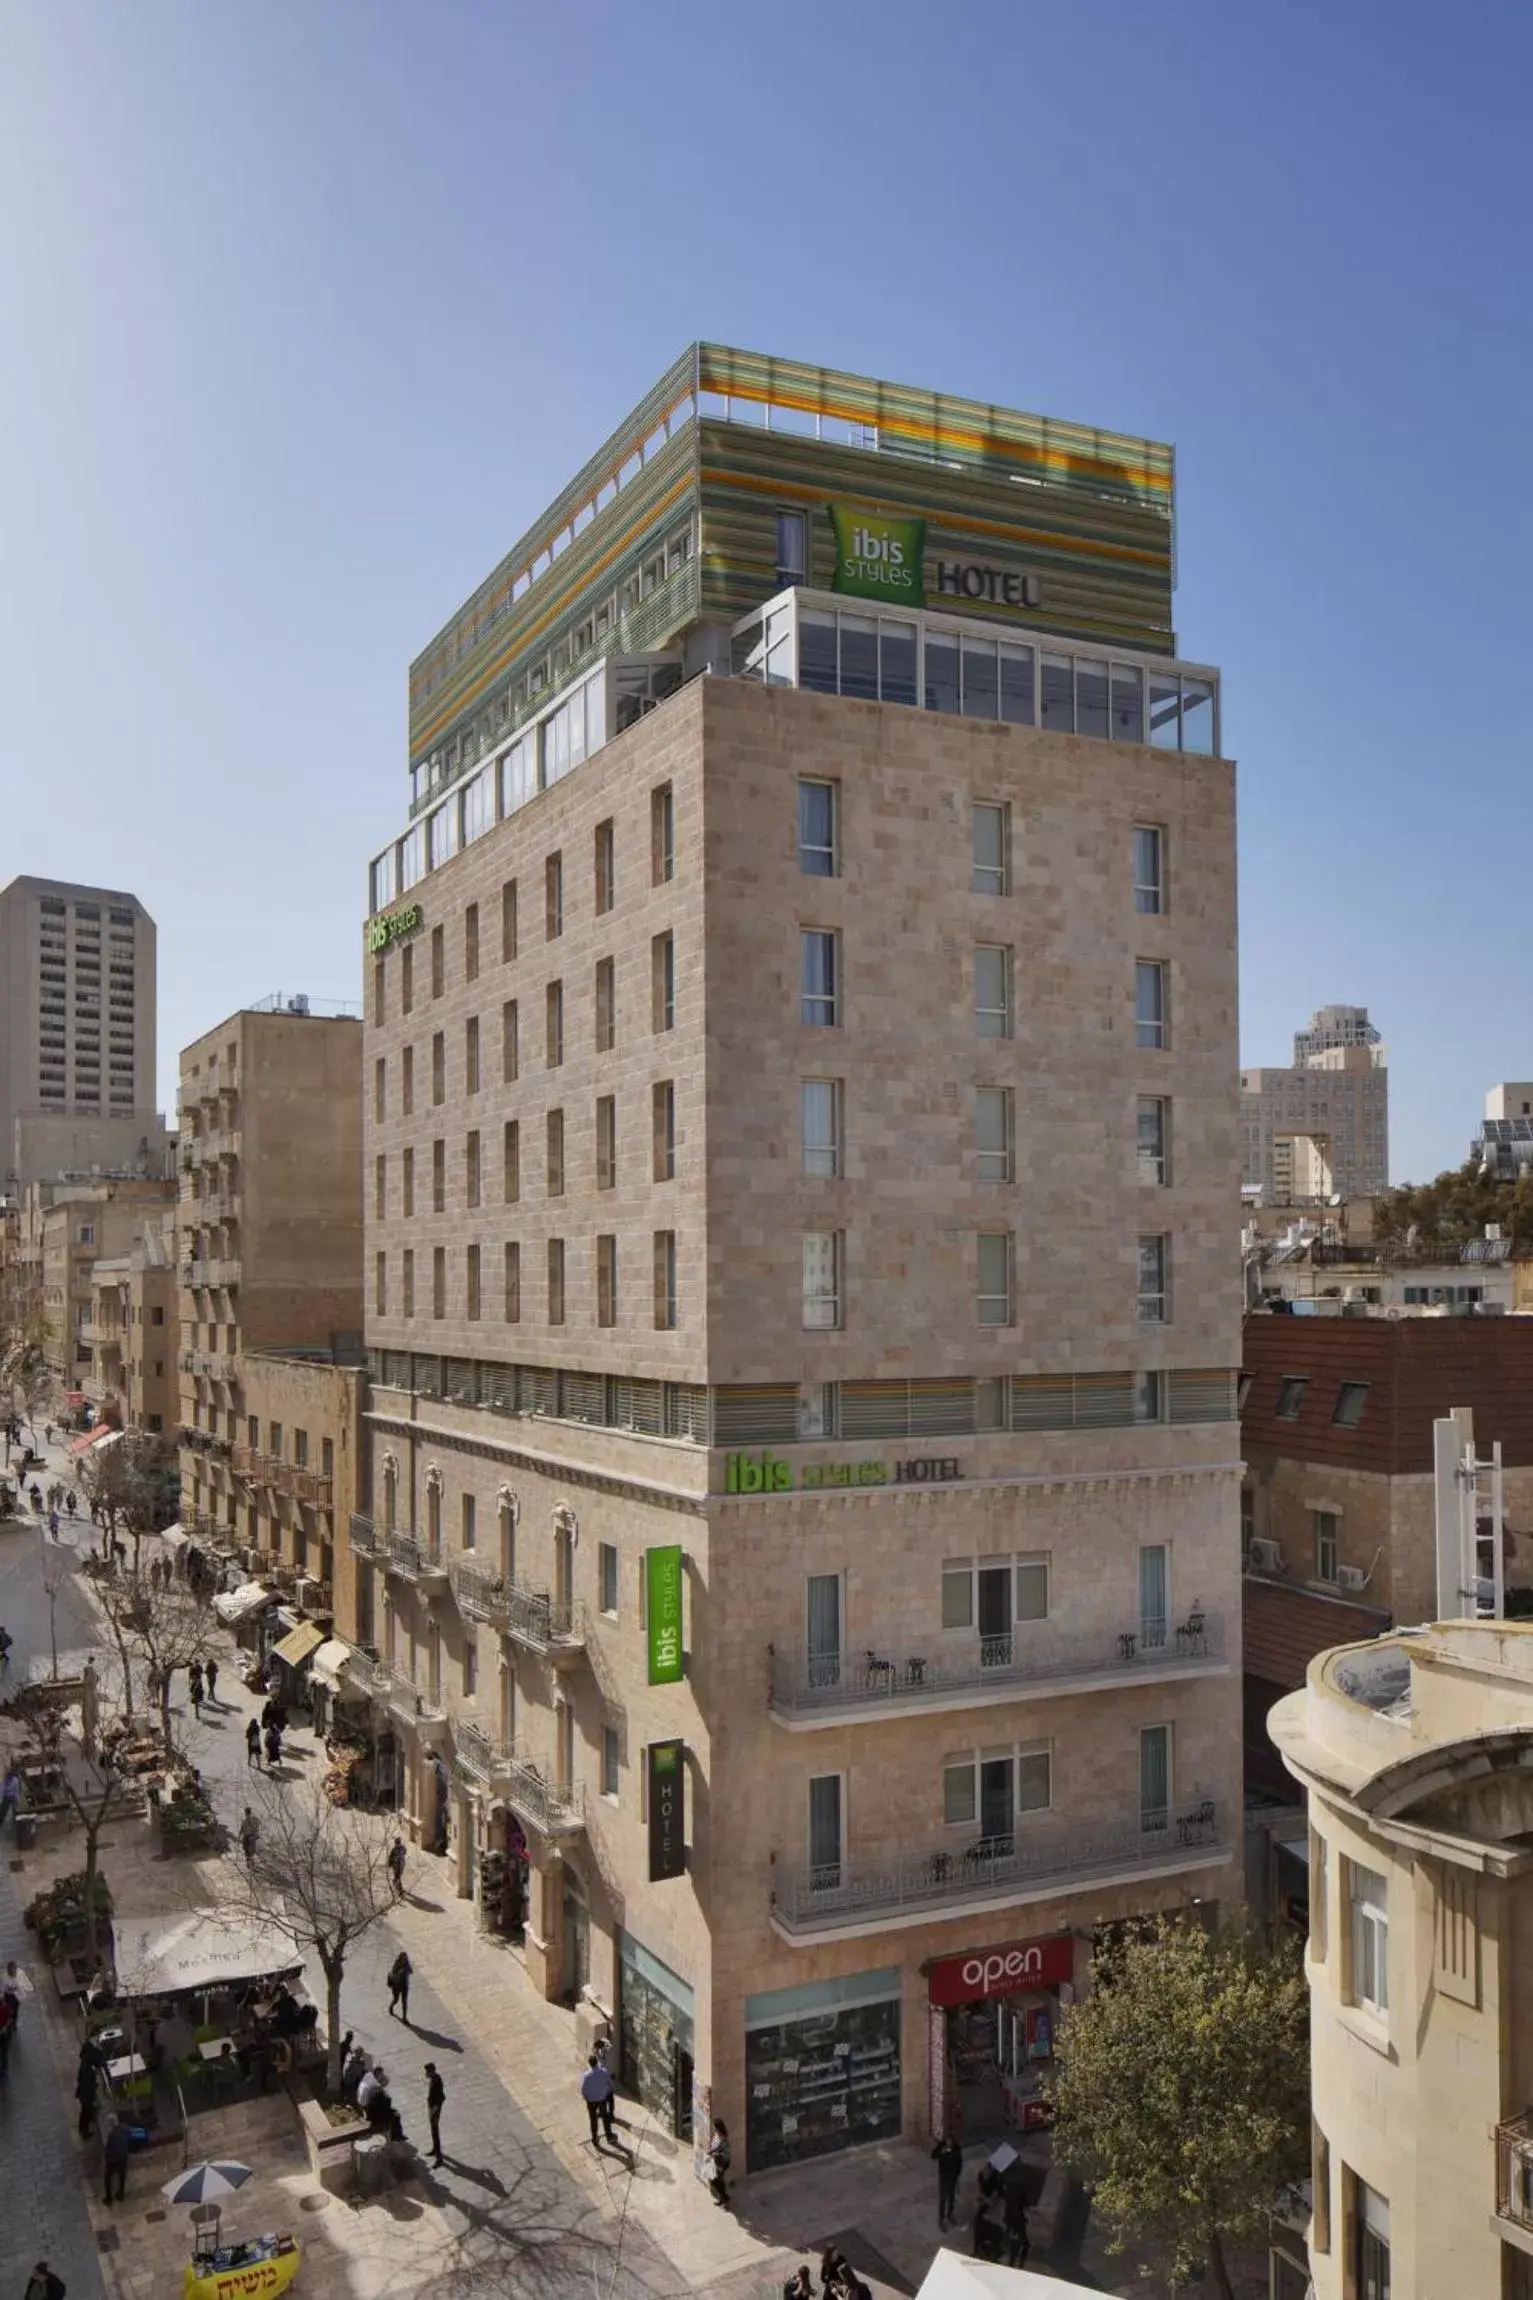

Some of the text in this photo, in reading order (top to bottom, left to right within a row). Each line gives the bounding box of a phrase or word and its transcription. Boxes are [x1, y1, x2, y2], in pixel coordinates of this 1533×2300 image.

[852, 527, 904, 564] ibis
[937, 561, 1041, 607] HOTEL
[368, 916, 387, 951] ibis
[724, 1448, 793, 1492] ibis
[895, 1457, 965, 1482] HOTEL
[656, 1626, 676, 1668] ibis
[661, 1784, 673, 1869] HOTEL
[962, 1947, 1042, 1994] open
